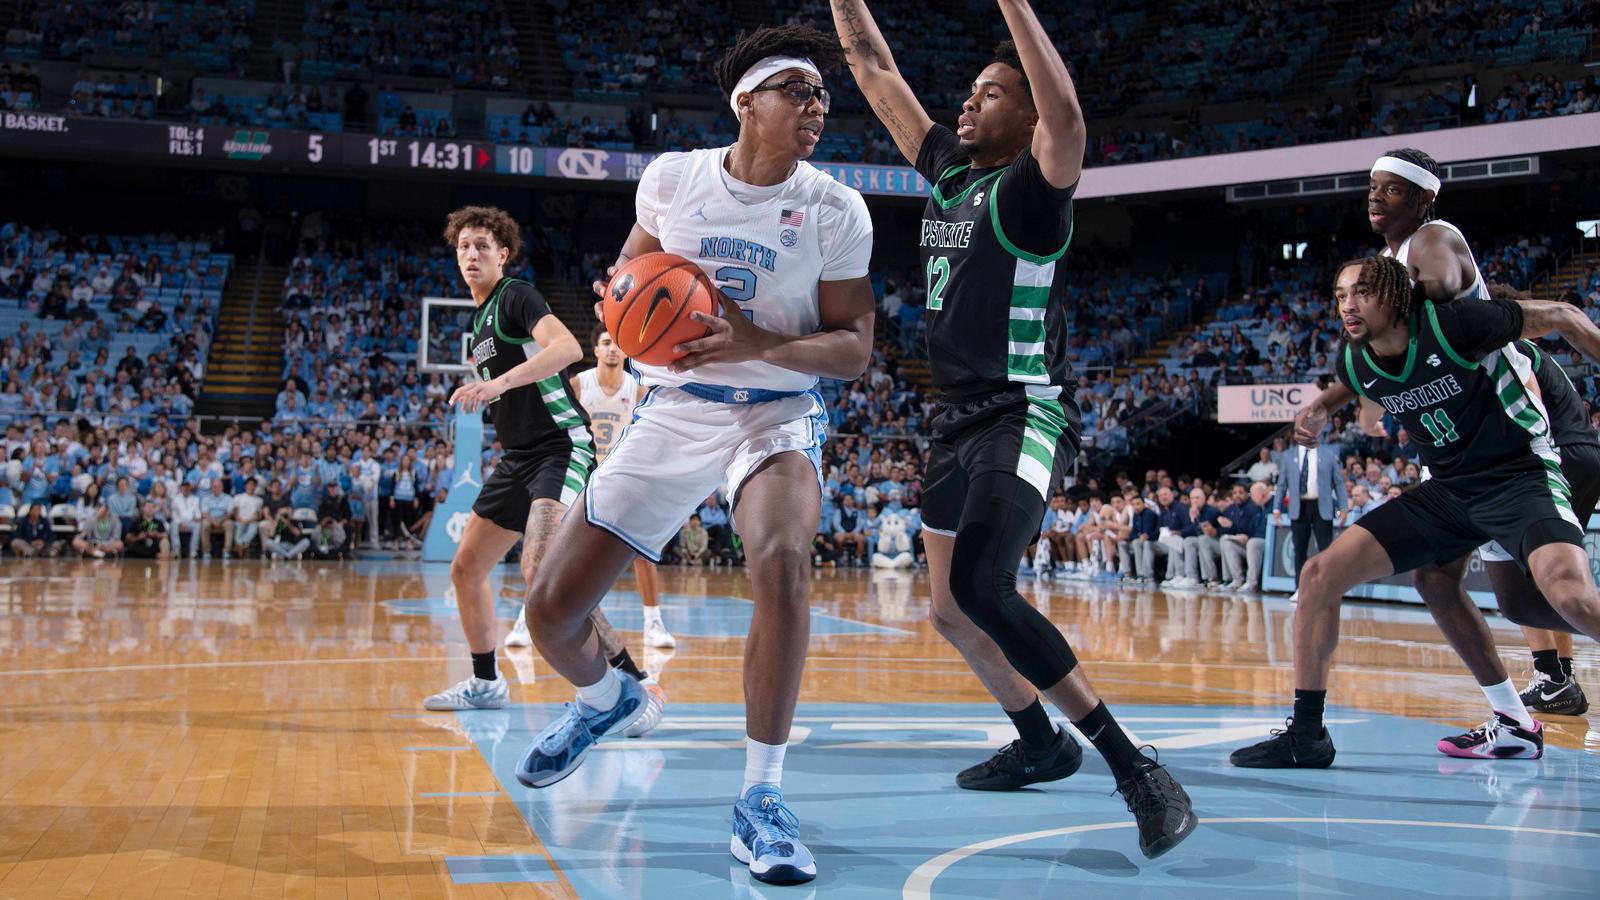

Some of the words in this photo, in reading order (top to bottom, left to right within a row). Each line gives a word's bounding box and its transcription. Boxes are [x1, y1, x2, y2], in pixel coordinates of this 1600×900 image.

[5, 115, 69, 132] BASKET.
[168, 126, 195, 141] TOL:
[195, 127, 204, 141] 4
[168, 140, 195, 156] FLS:
[195, 142, 203, 156] 1
[307, 134, 324, 164] 5
[367, 137, 398, 165] 1ST
[408, 140, 473, 171] 14:31
[507, 146, 534, 174] 10
[821, 168, 926, 192] ASKETB
[699, 236, 778, 273] NORTH
[926, 255, 951, 311] 12
[1251, 388, 1302, 406] UNC
[1379, 373, 1463, 415] UPSTATE
[596, 423, 614, 445] 3
[1420, 407, 1460, 448] 11
